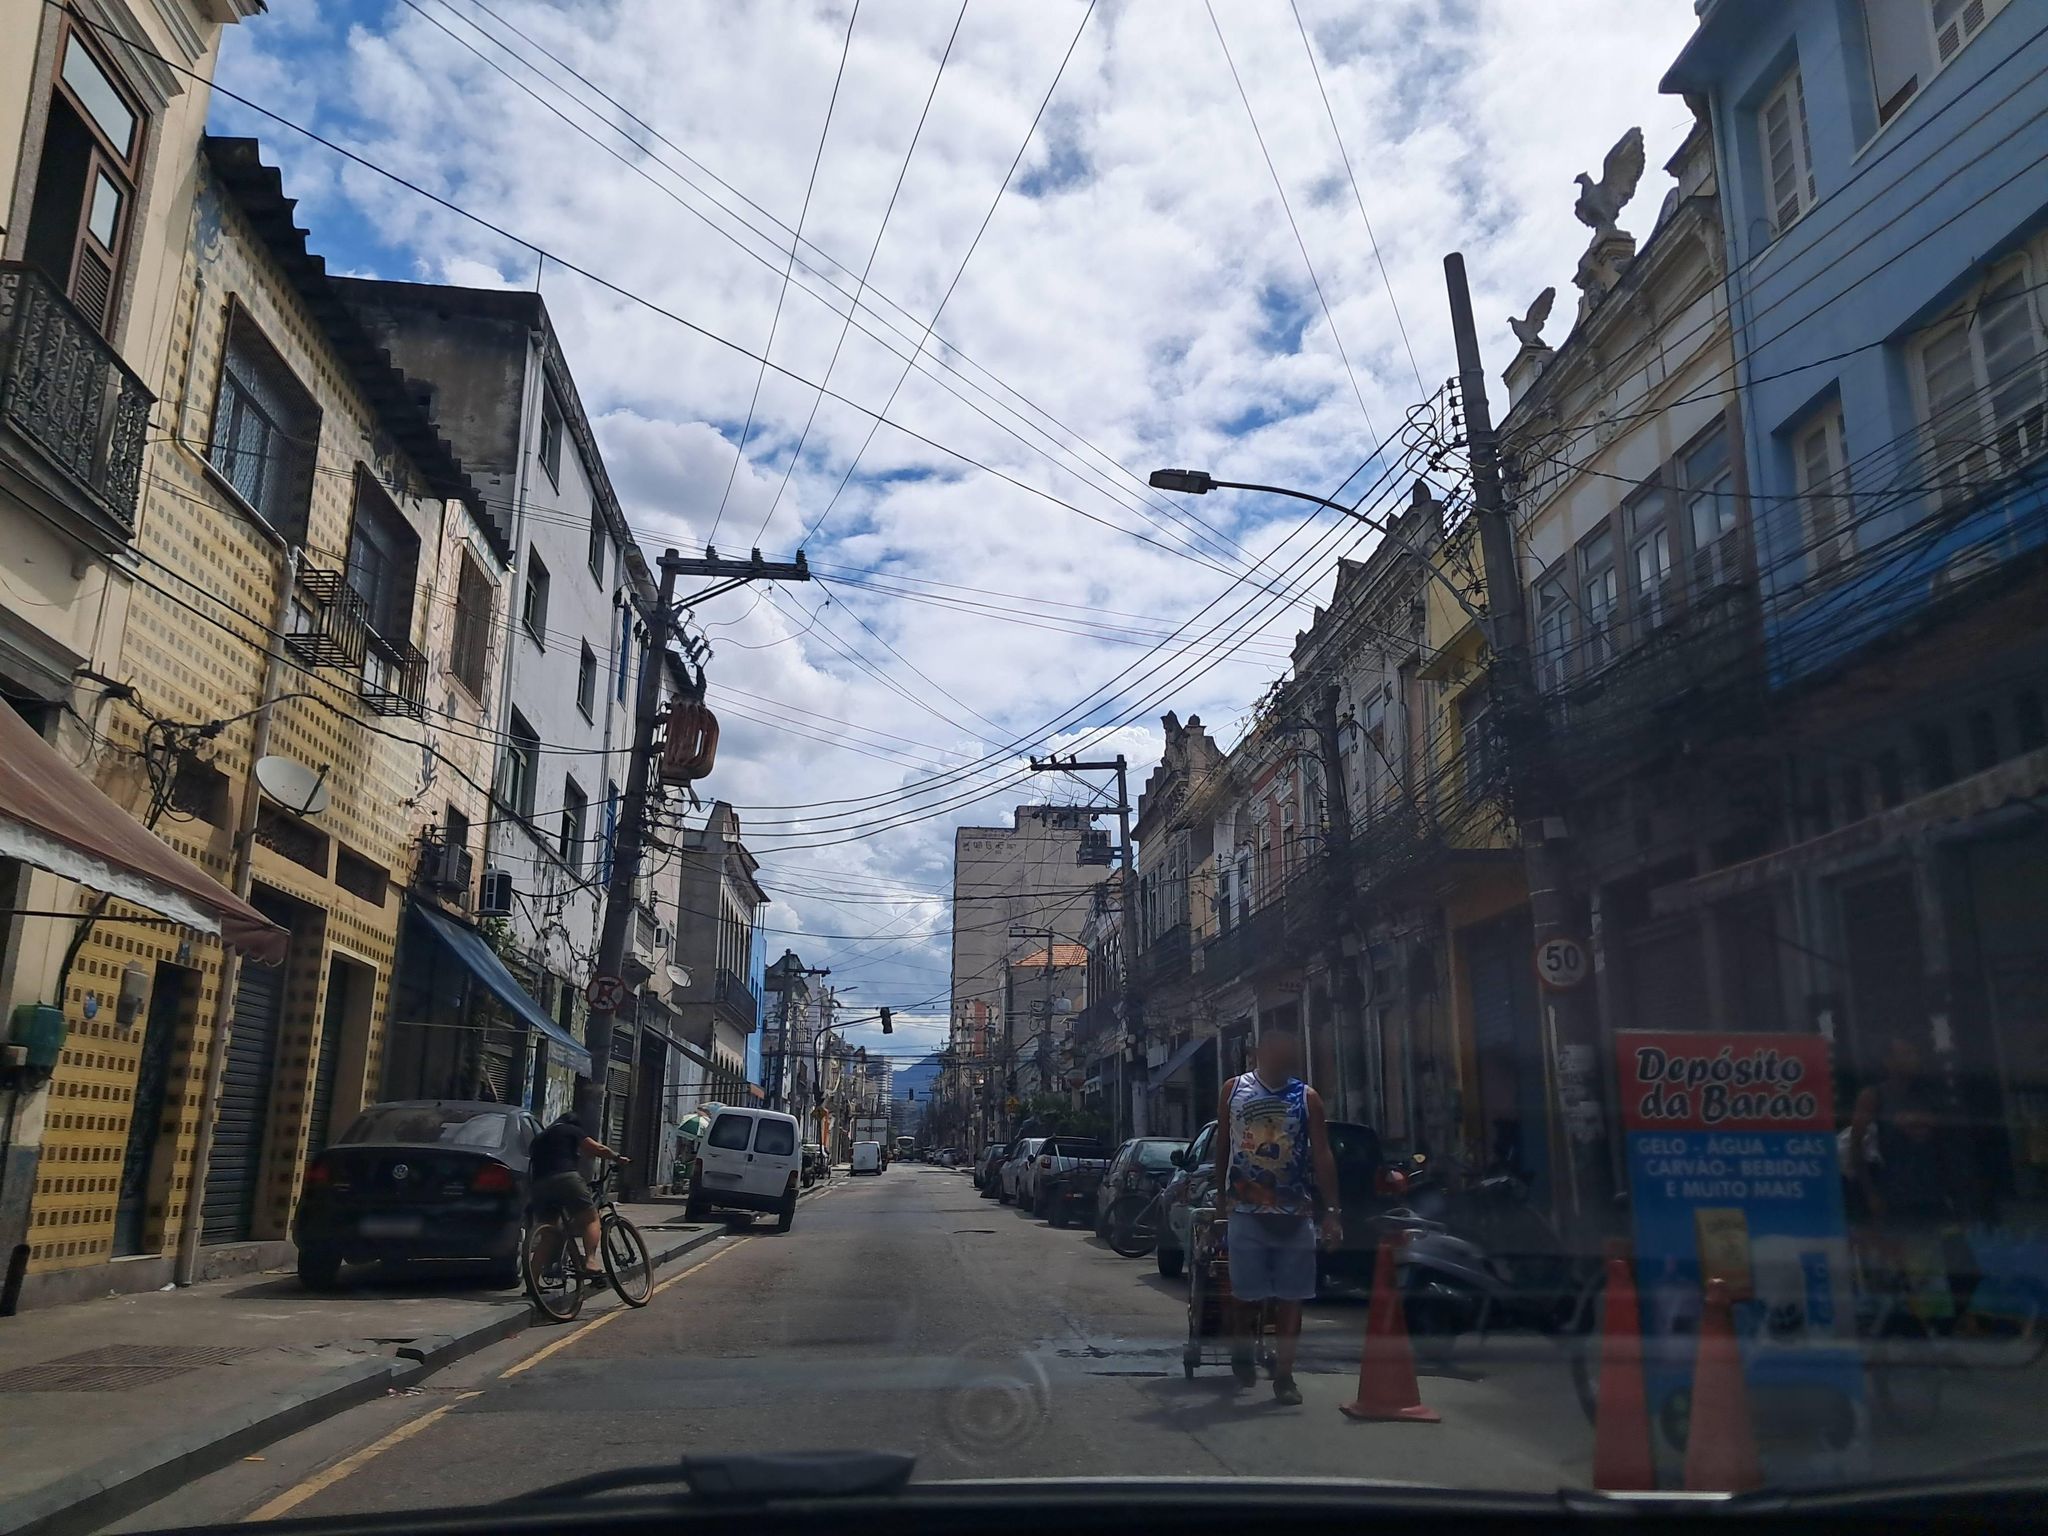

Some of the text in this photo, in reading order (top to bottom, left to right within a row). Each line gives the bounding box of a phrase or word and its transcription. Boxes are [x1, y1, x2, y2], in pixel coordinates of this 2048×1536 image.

[1546, 946, 1577, 971] 50
[1636, 1046, 1804, 1091] Depósito
[1640, 1081, 1816, 1124] da Barão
[1638, 1137, 1686, 1154] GELO
[1707, 1134, 1766, 1154] ÁGUA
[1741, 1159, 1822, 1176] BEBIDAS
[1665, 1181, 1804, 1198] E MUITO MAIS
